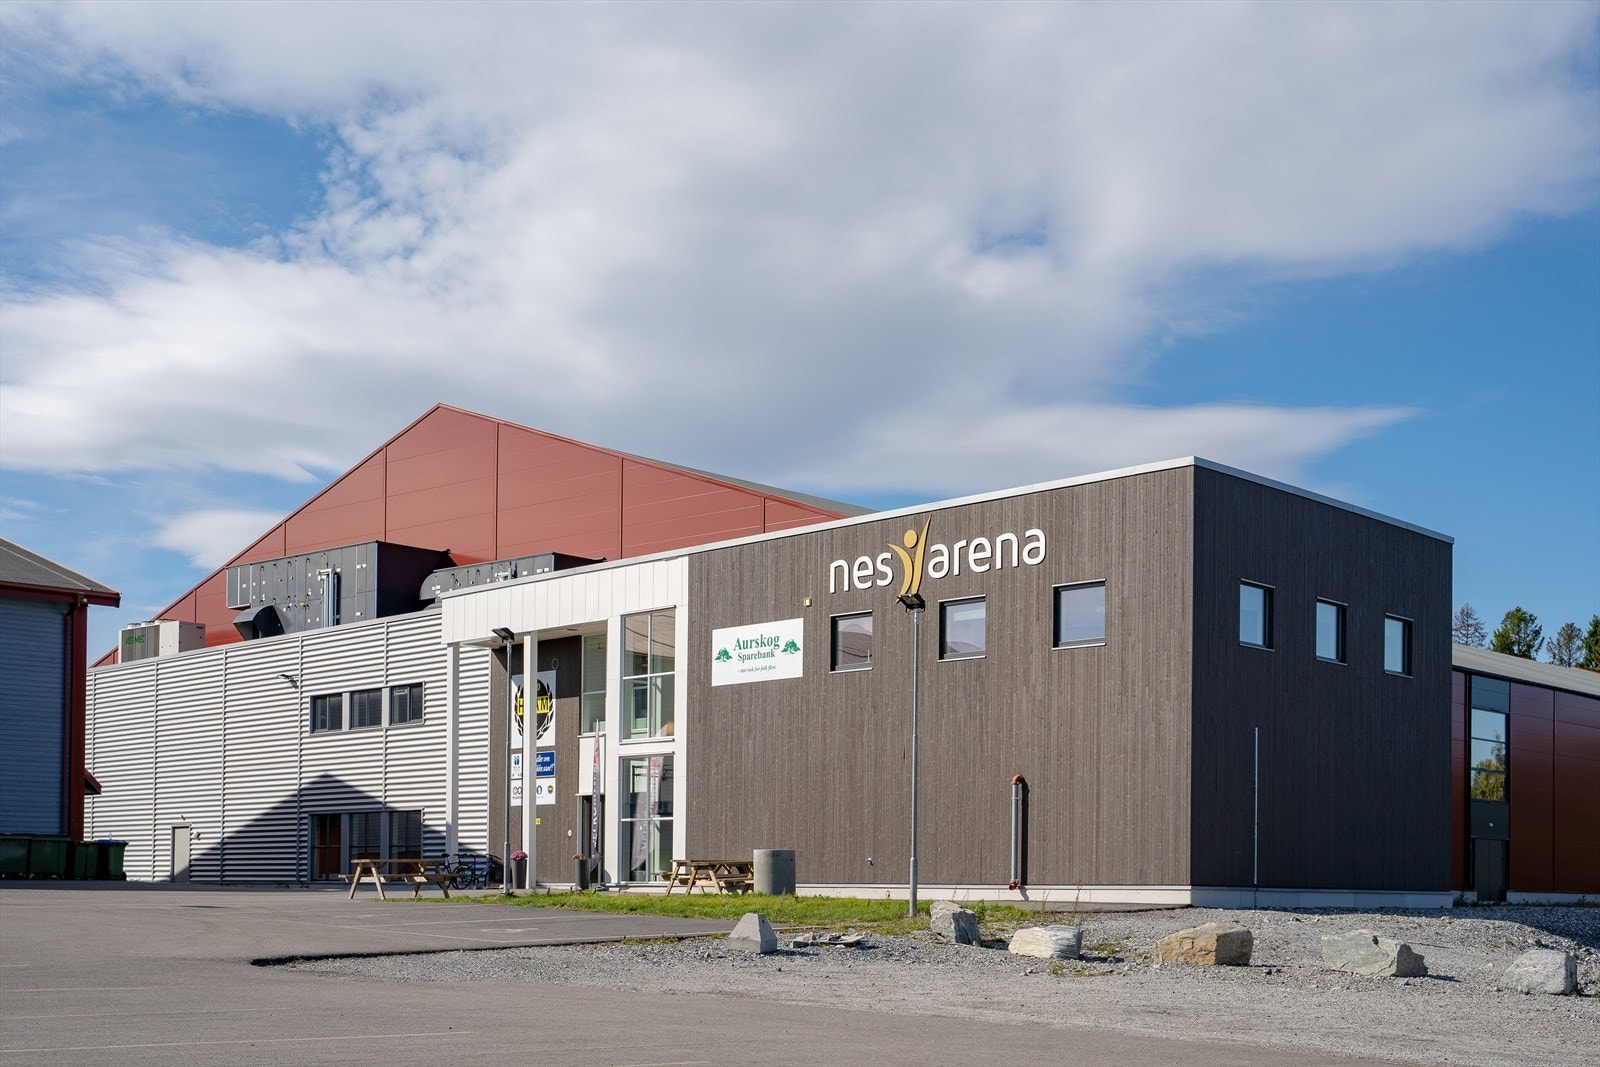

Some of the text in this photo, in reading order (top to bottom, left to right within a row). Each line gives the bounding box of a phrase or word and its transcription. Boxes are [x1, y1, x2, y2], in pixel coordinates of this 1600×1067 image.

[829, 528, 1046, 593] nes arena
[734, 634, 780, 650] Aurskog
[738, 649, 775, 663] Sparebank
